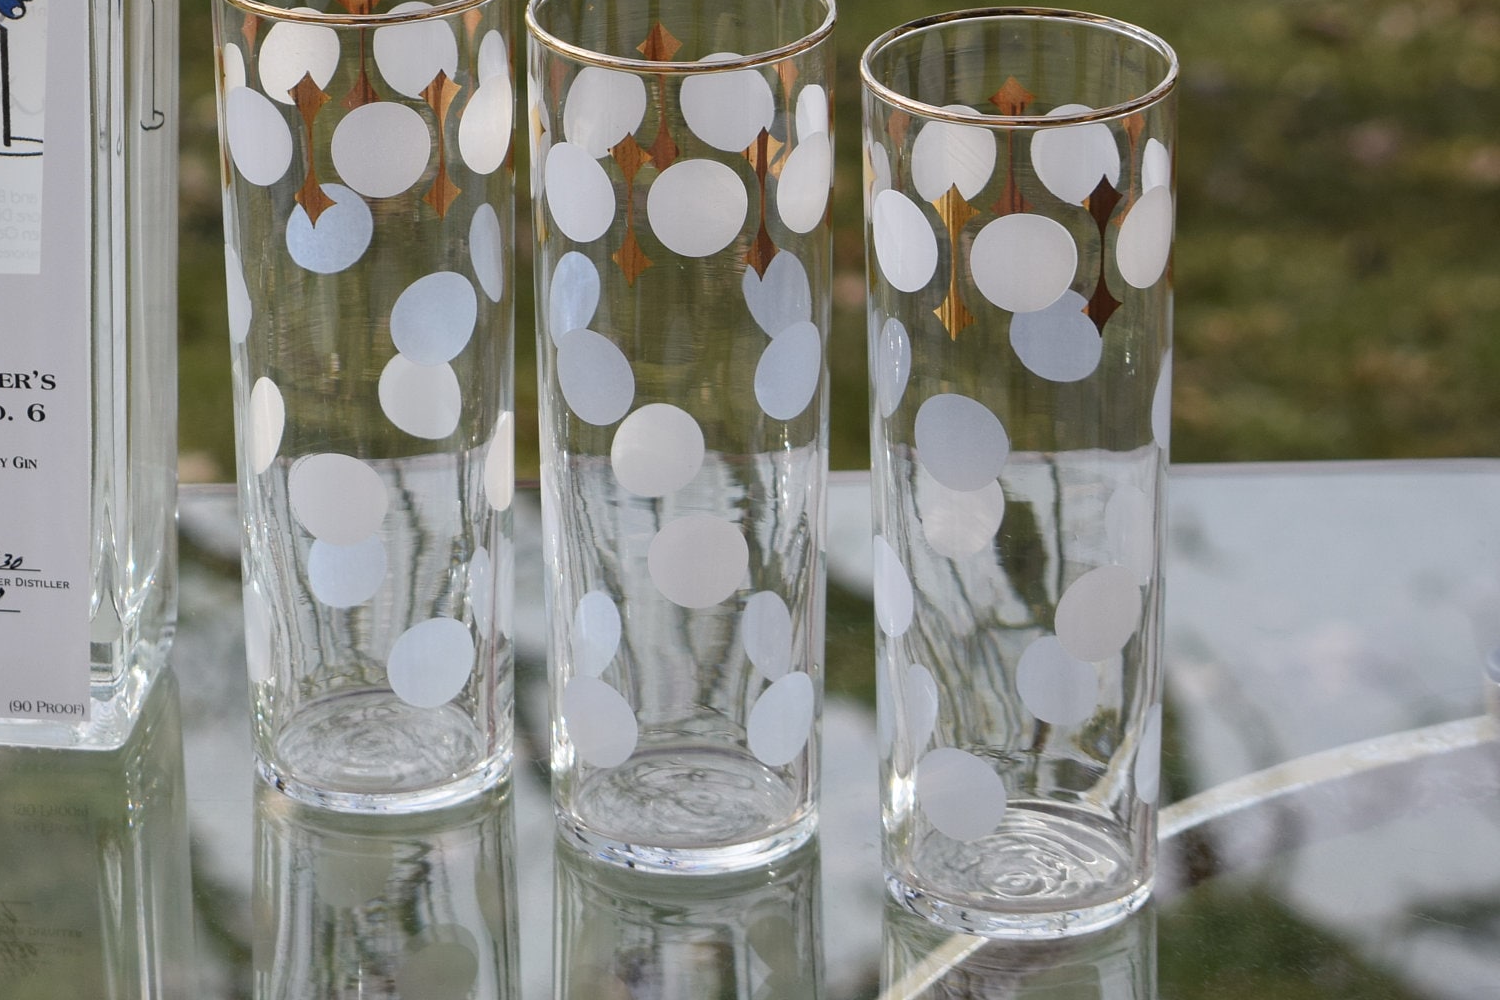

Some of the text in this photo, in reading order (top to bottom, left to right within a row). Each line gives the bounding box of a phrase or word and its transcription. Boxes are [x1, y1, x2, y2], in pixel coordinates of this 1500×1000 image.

[27, 403, 46, 422] 6
[12, 456, 38, 470] GIN
[15, 577, 70, 589] DISTILLER
[9, 699, 32, 713] (90
[36, 700, 86, 716] PROOF)
